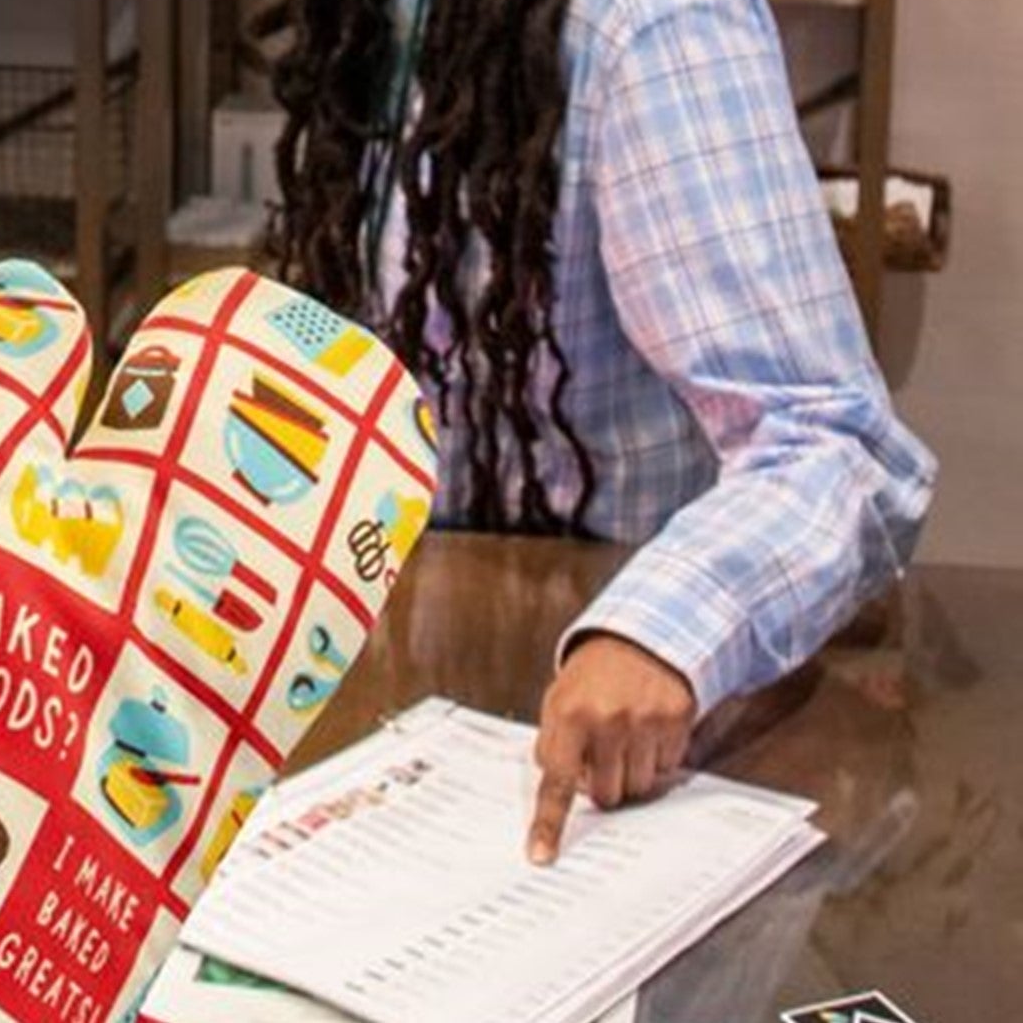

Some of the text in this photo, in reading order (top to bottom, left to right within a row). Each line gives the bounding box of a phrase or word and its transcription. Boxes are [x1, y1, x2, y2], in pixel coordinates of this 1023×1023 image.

[52, 834, 140, 933] I MAKE
[35, 889, 110, 974] BAKED
